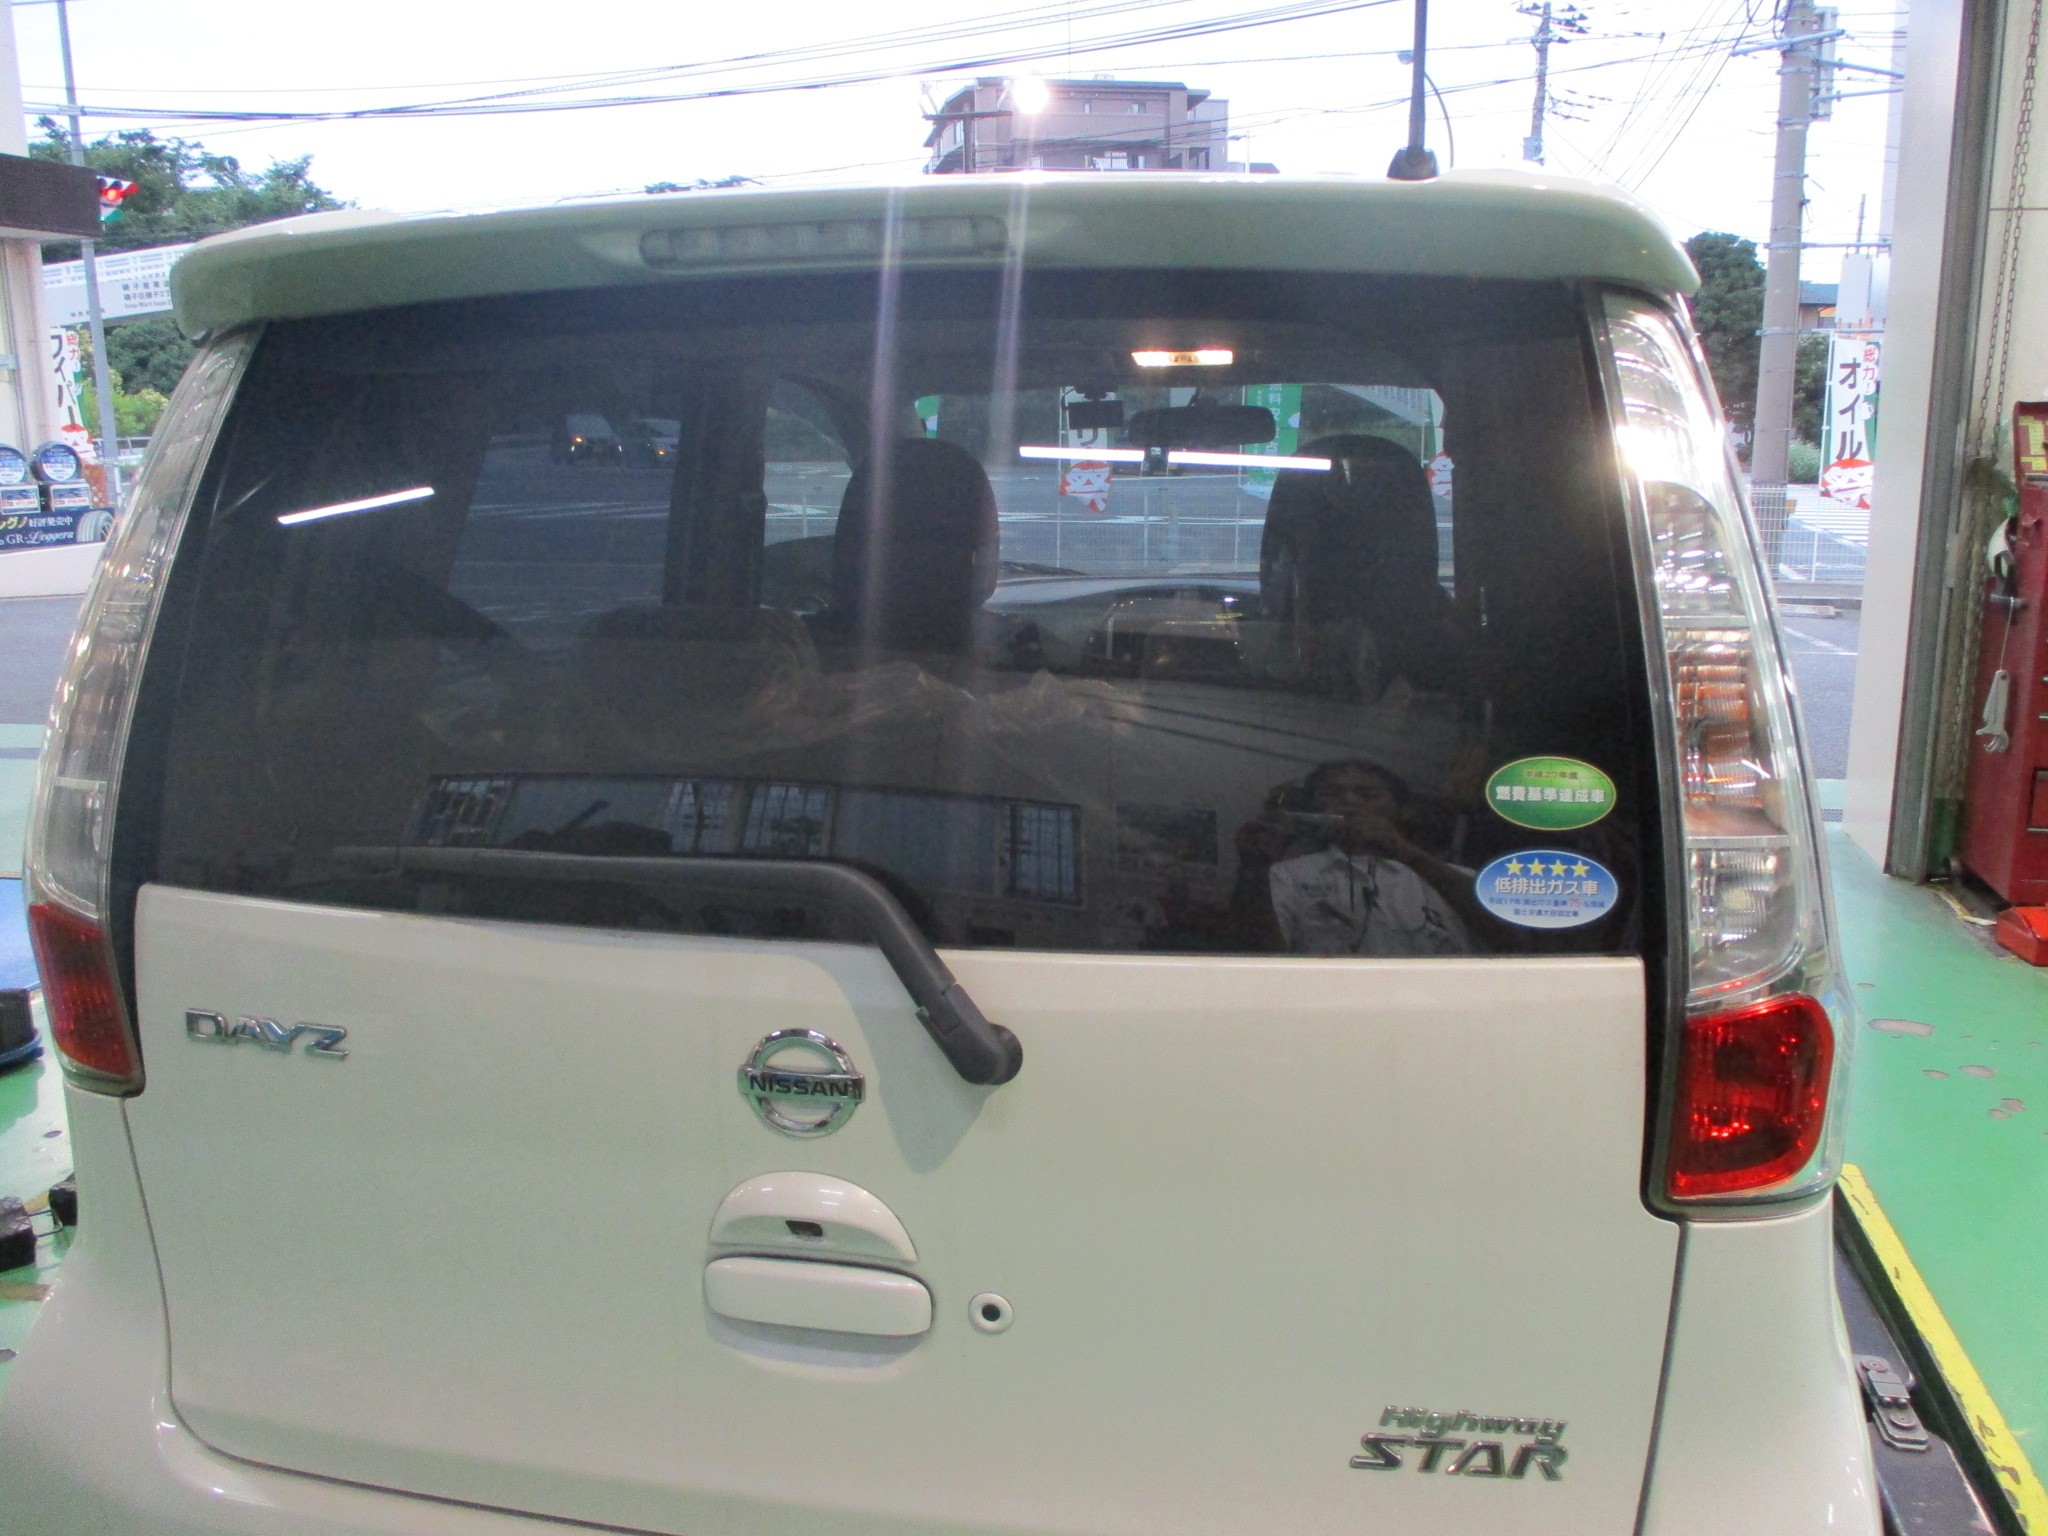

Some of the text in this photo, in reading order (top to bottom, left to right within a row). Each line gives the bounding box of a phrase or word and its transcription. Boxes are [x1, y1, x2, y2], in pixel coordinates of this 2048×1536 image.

[1494, 877, 1599, 897] 低排出ガス車
[185, 1007, 350, 1061] DAYZ
[750, 1075, 848, 1097] NISSAN
[1378, 1405, 1568, 1444] Highway
[1349, 1432, 1569, 1481] STAR
